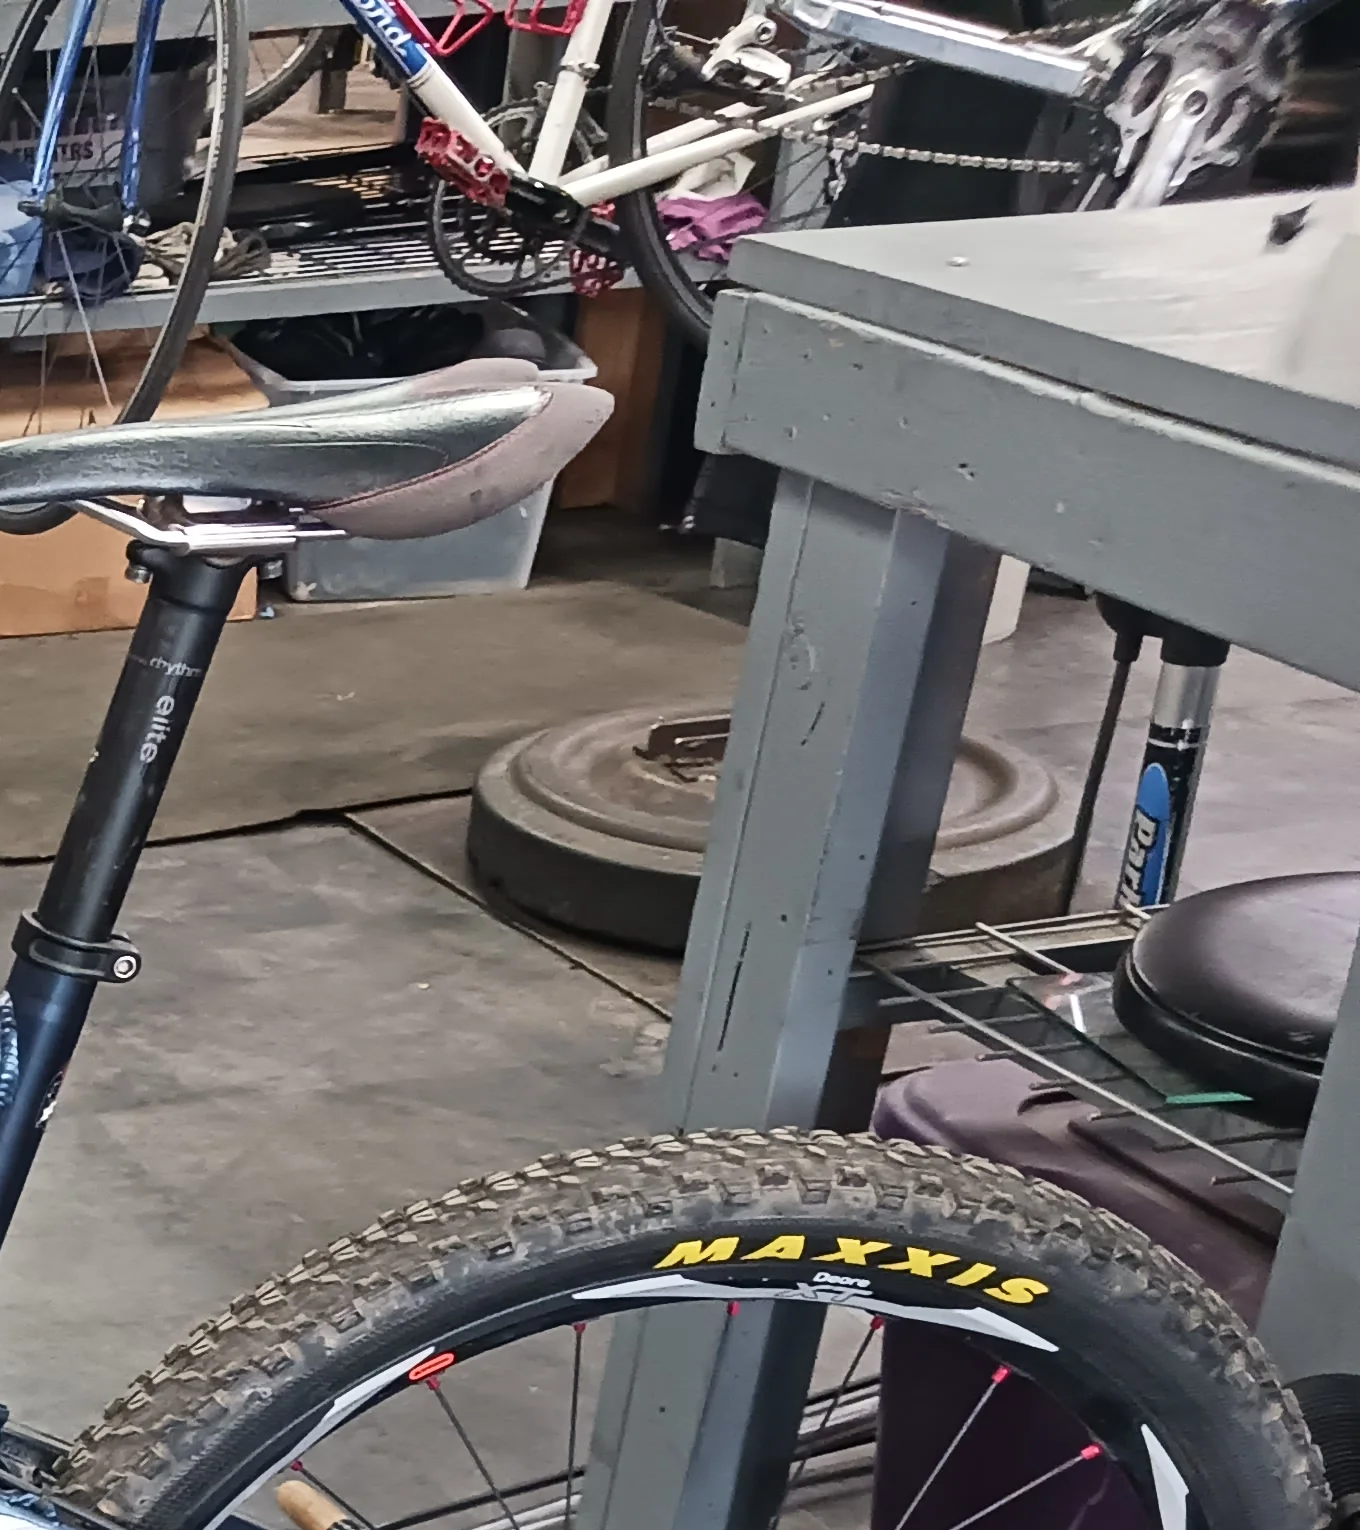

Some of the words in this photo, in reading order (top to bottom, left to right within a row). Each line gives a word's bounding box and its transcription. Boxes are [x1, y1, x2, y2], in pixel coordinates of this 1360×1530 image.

[140, 695, 175, 763] elite
[653, 1234, 1050, 1304] MAXXIS
[812, 1271, 872, 1288] Deore
